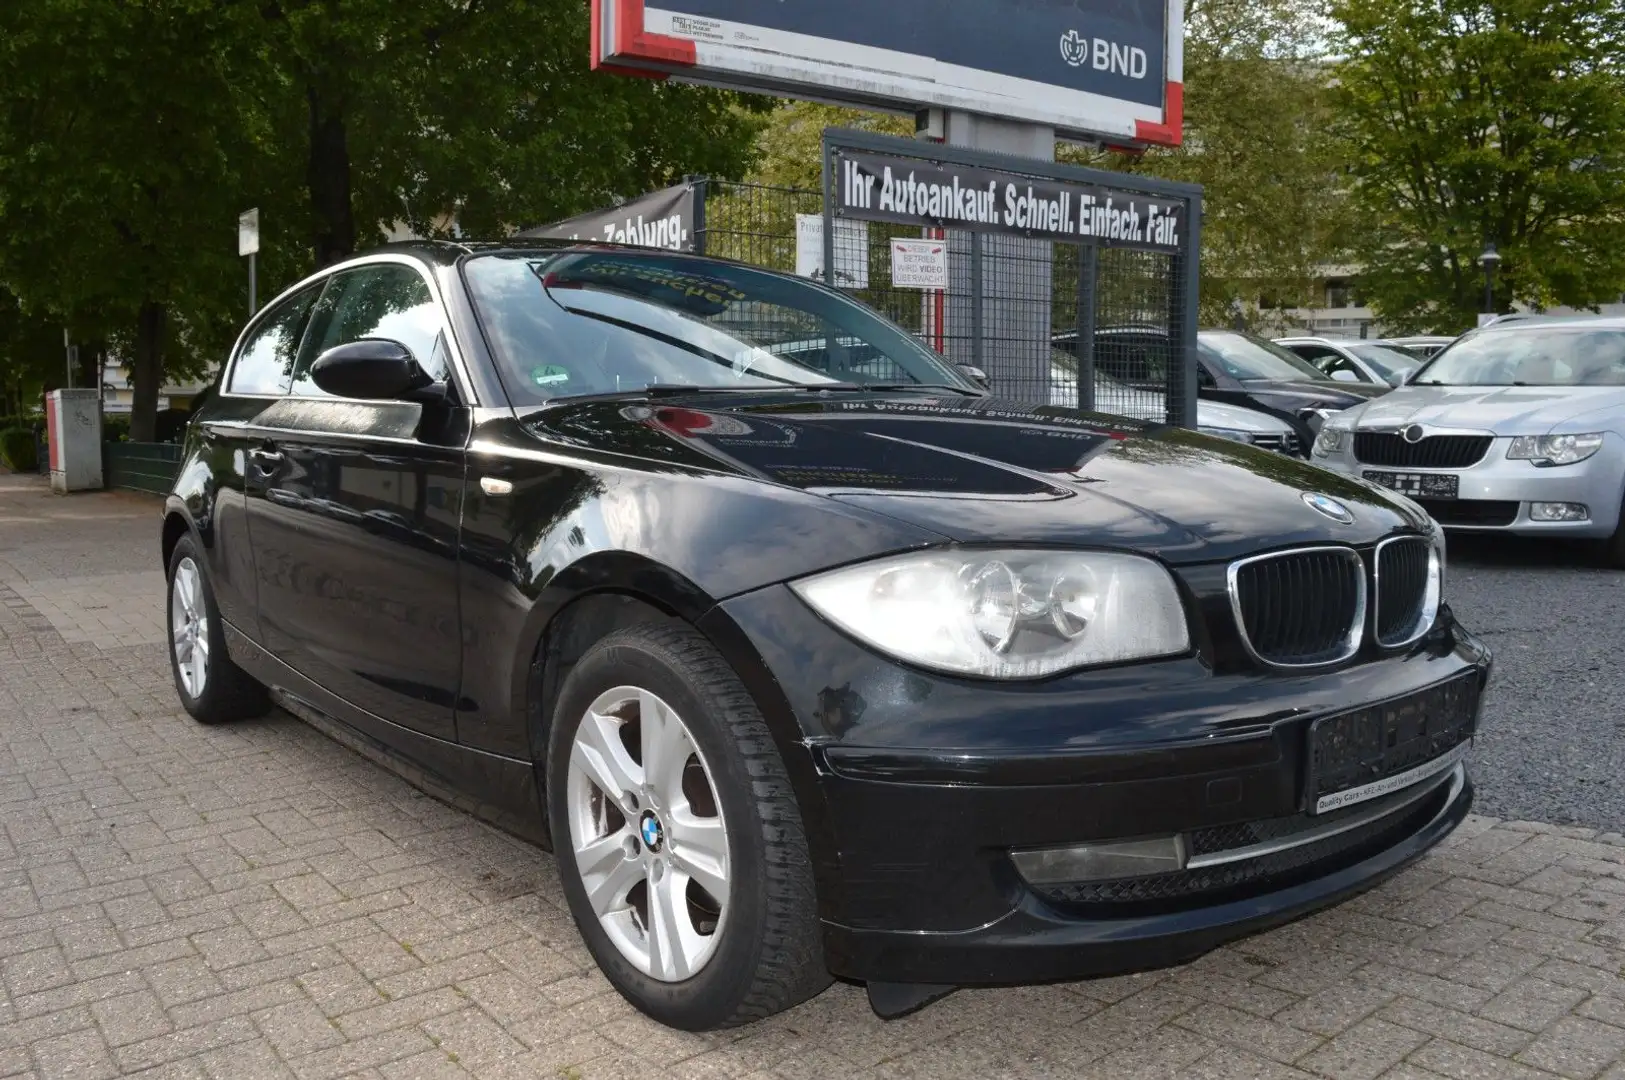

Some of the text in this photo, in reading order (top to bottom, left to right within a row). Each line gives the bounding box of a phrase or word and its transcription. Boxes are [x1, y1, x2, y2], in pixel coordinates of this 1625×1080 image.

[1092, 37, 1147, 80] BND
[844, 159, 1179, 246] Ihr Autoankauf. Schnell. Einfach. Fair.
[603, 213, 687, 251] Zahlung.
[919, 265, 943, 274] VIDEO
[1319, 796, 1344, 809] Quality
[1344, 791, 1360, 802] Cars
